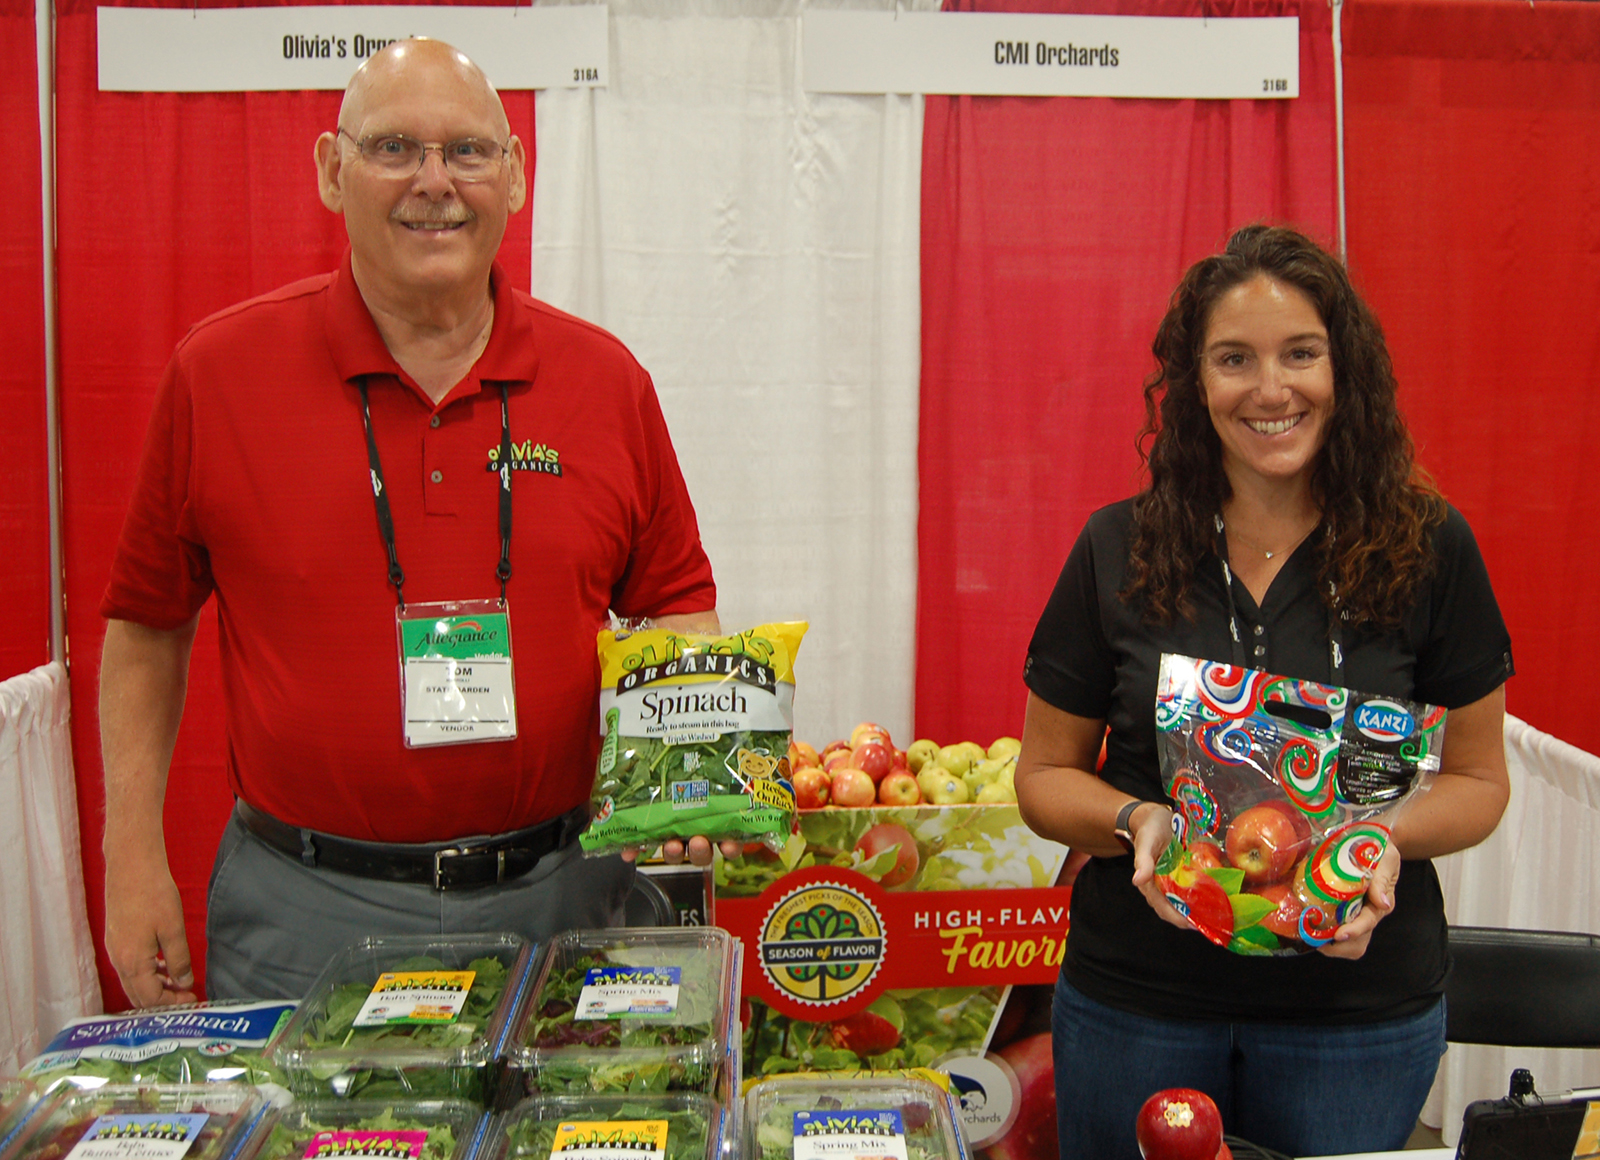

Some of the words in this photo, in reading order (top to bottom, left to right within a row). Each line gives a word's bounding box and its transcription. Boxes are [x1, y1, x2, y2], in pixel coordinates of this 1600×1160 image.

[283, 35, 347, 59] Olivia's
[994, 41, 1029, 65] CMI
[1036, 42, 1119, 67] Orchards
[574, 69, 599, 81] 316A
[624, 655, 767, 689] ORGANICS
[640, 685, 748, 724] Spinach
[646, 723, 668, 734] Ready
[669, 722, 678, 730] to
[678, 721, 701, 729] steam
[701, 719, 710, 728] in
[710, 719, 724, 727] this
[725, 719, 740, 729] bag
[688, 733, 715, 742] Washed
[757, 791, 771, 804] On
[741, 816, 754, 824] Net
[755, 815, 767, 823] Wt.
[770, 922, 778, 938] THE
[777, 896, 808, 923] FRESHEST
[808, 893, 831, 901] PICKS
[832, 893, 843, 901] OF
[844, 898, 857, 909] THE
[857, 906, 874, 934] SEASON
[914, 906, 1070, 929] HIGH-FLAV
[768, 947, 813, 960] SEASON
[816, 945, 831, 960] of
[833, 945, 876, 957] FLAVOR
[149, 1014, 251, 1034] Spinach
[108, 1047, 137, 1061] Triple
[137, 1042, 173, 1057] Washed
[963, 1112, 1001, 1123] rchards
[813, 1141, 857, 1151] Spring
[861, 1140, 887, 1148] Mix
